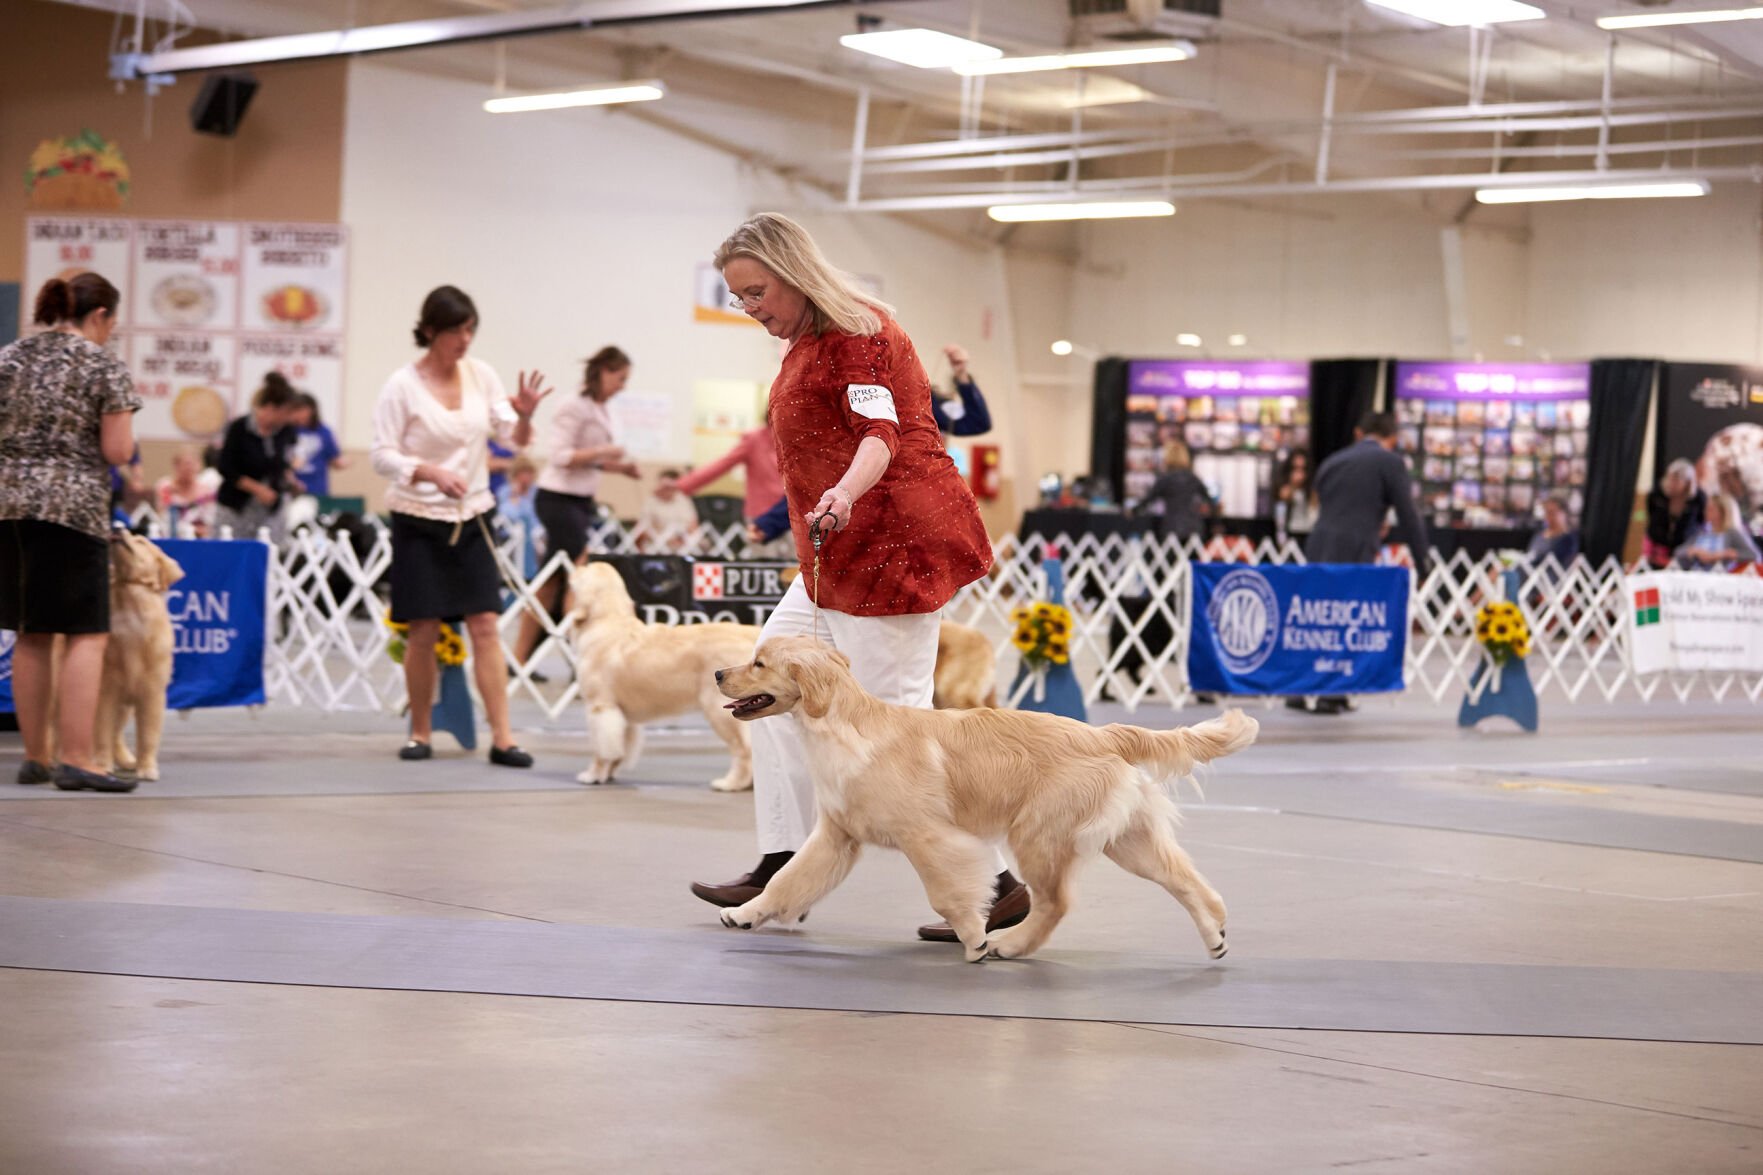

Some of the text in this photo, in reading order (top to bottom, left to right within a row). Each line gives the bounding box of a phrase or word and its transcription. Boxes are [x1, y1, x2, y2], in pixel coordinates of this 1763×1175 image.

[850, 394, 879, 405] PLAN
[853, 388, 878, 397] PRO
[1285, 594, 1387, 627] AMERICAN
[1283, 627, 1343, 651] KENNEL
